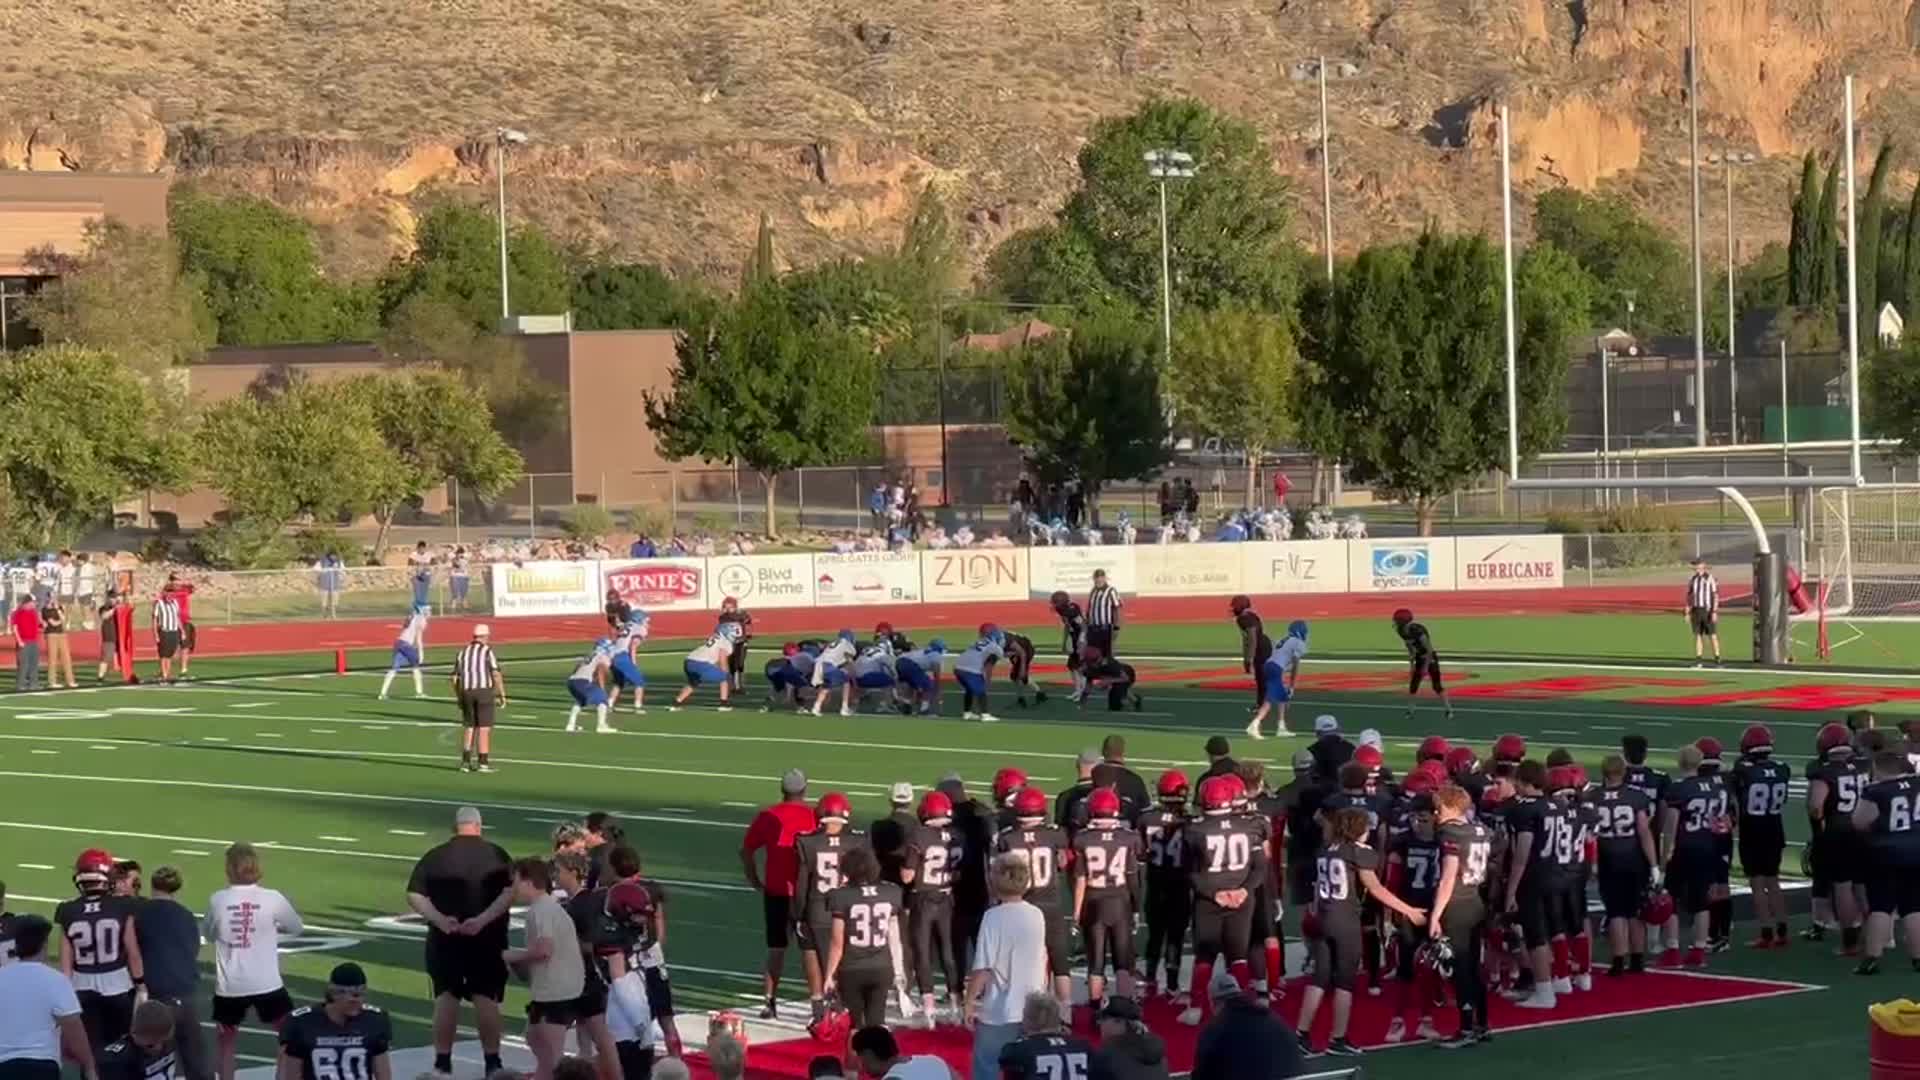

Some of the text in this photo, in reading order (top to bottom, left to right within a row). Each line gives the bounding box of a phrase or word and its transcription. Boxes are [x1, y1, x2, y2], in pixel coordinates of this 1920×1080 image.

[609, 569, 698, 596] ERNIE'S
[758, 568, 793, 581] Blvd
[935, 554, 1018, 589] ZION
[1373, 577, 1433, 590] eyecare
[1466, 562, 1555, 580] HURRICANE
[759, 582, 804, 596] Home
[1746, 783, 1787, 816] 88
[1084, 845, 1128, 889] 24
[1206, 832, 1249, 873] 70
[849, 902, 893, 947] 33
[67, 917, 121, 966] 20
[311, 1047, 369, 1080] 60
